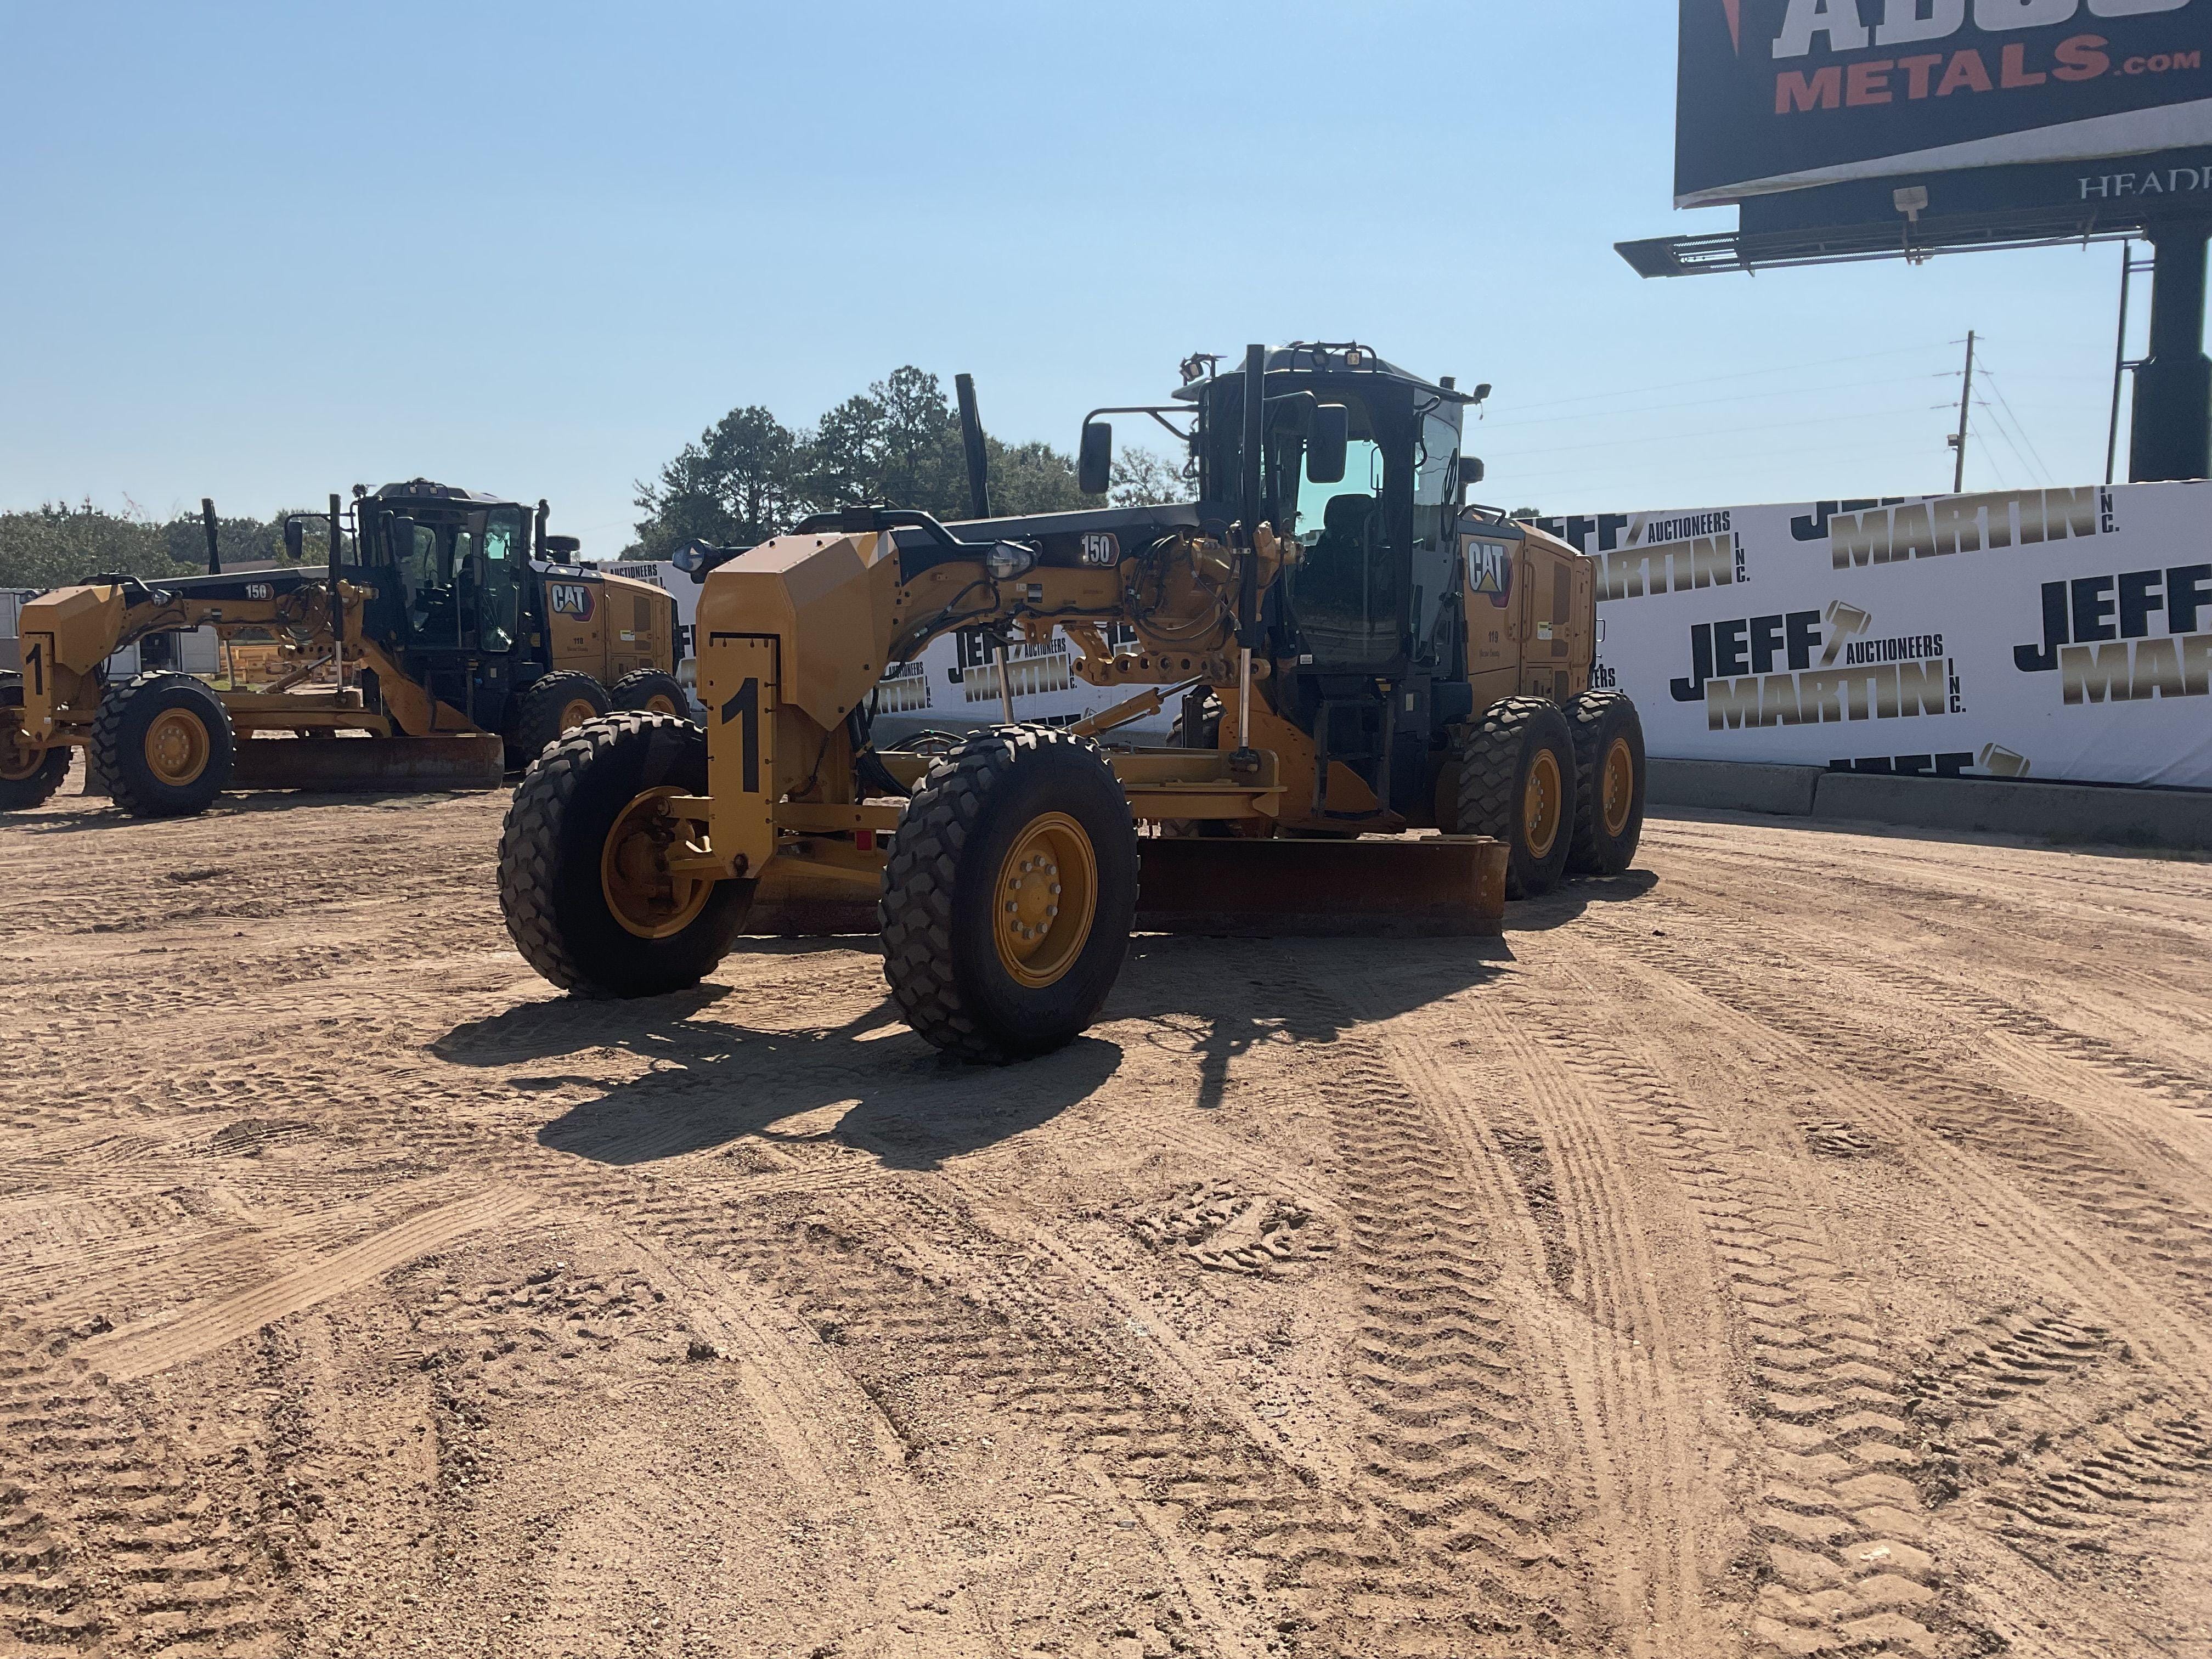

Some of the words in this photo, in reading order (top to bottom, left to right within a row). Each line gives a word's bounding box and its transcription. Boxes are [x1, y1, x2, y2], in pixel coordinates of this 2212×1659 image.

[2077, 166, 2212, 199] HEAD
[1081, 535, 1110, 563] 150
[1647, 511, 1730, 544] AUCTIONEERS
[1831, 486, 2096, 570] MARTIN
[1469, 543, 1503, 592] CAT
[1595, 534, 1733, 602] RTIN
[1735, 532, 1751, 583] INC.
[246, 584, 267, 599] 150
[552, 585, 584, 613] CAT
[1488, 630, 1499, 644] 119
[2013, 563, 2212, 673] JEFF
[26, 643, 43, 696] 1
[1669, 610, 1822, 702] JEFF
[1846, 634, 1944, 665] AUCTIONEERS
[1706, 659, 1945, 731] MARTIN
[1948, 658, 1966, 714] INC.
[721, 678, 760, 793] 1
